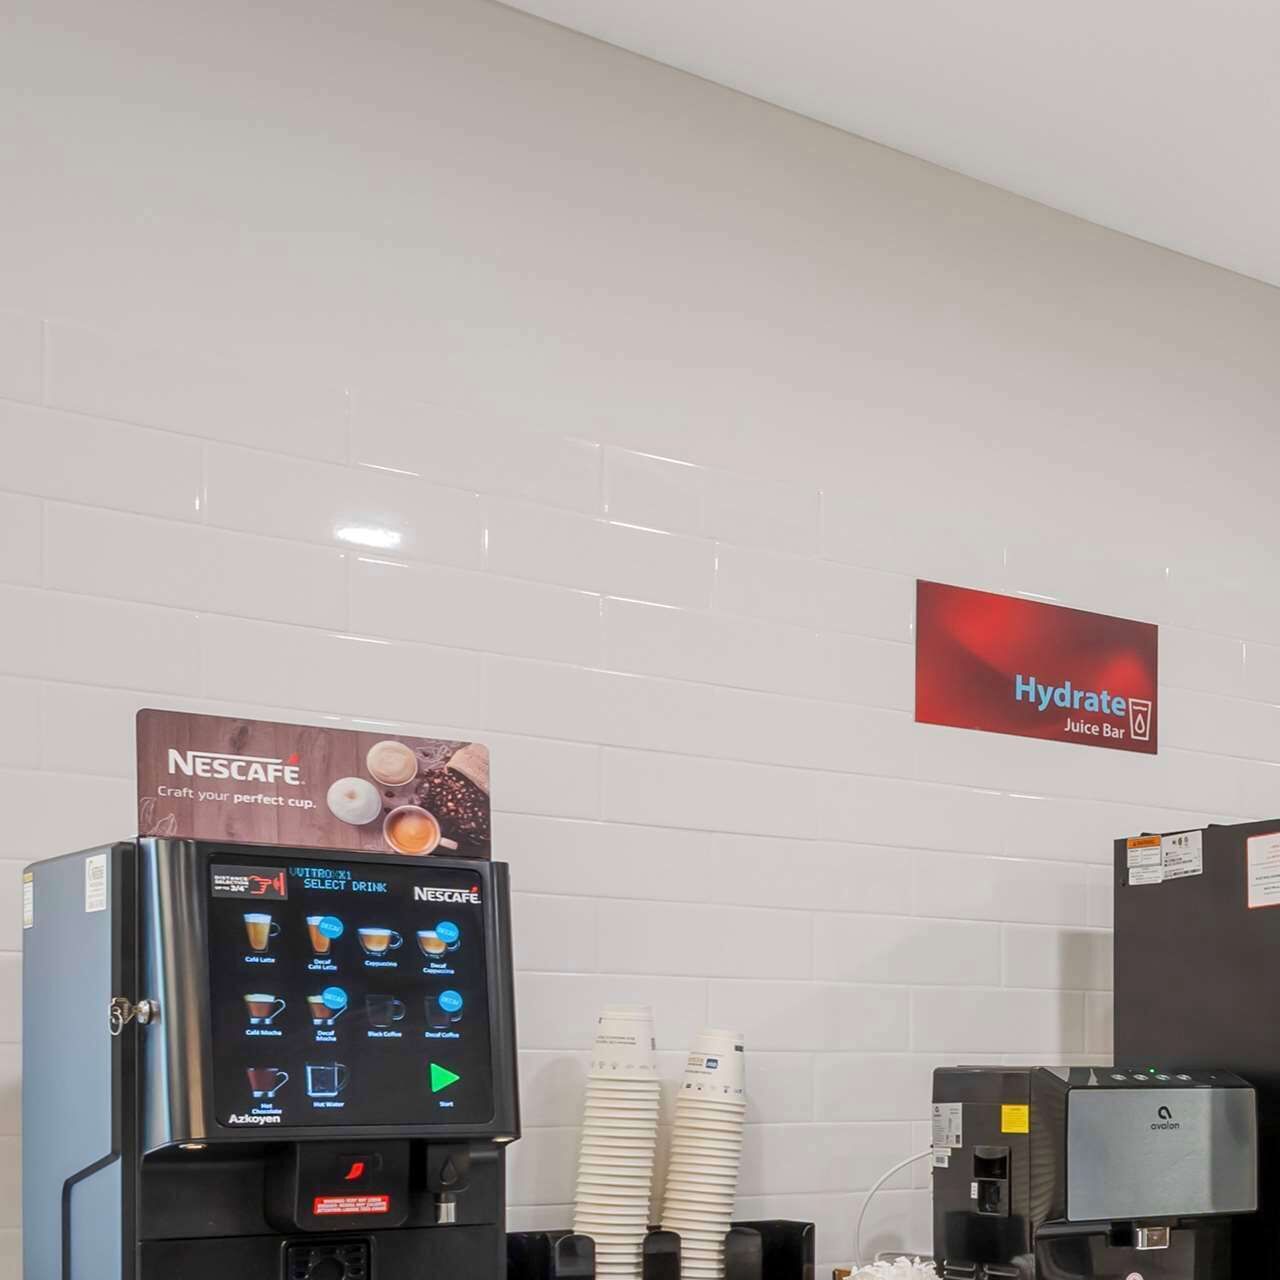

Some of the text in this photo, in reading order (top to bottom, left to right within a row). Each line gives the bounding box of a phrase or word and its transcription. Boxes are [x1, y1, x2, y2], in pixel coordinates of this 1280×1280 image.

[1014, 674, 1127, 717] Hydrate
[1064, 718, 1126, 739] Juice Bar
[158, 786, 317, 809] Craft your perfect cup.
[304, 878, 388, 892] SELECT DRINK
[229, 1114, 281, 1125] Azkoyen
[1150, 1121, 1180, 1130] avalon
